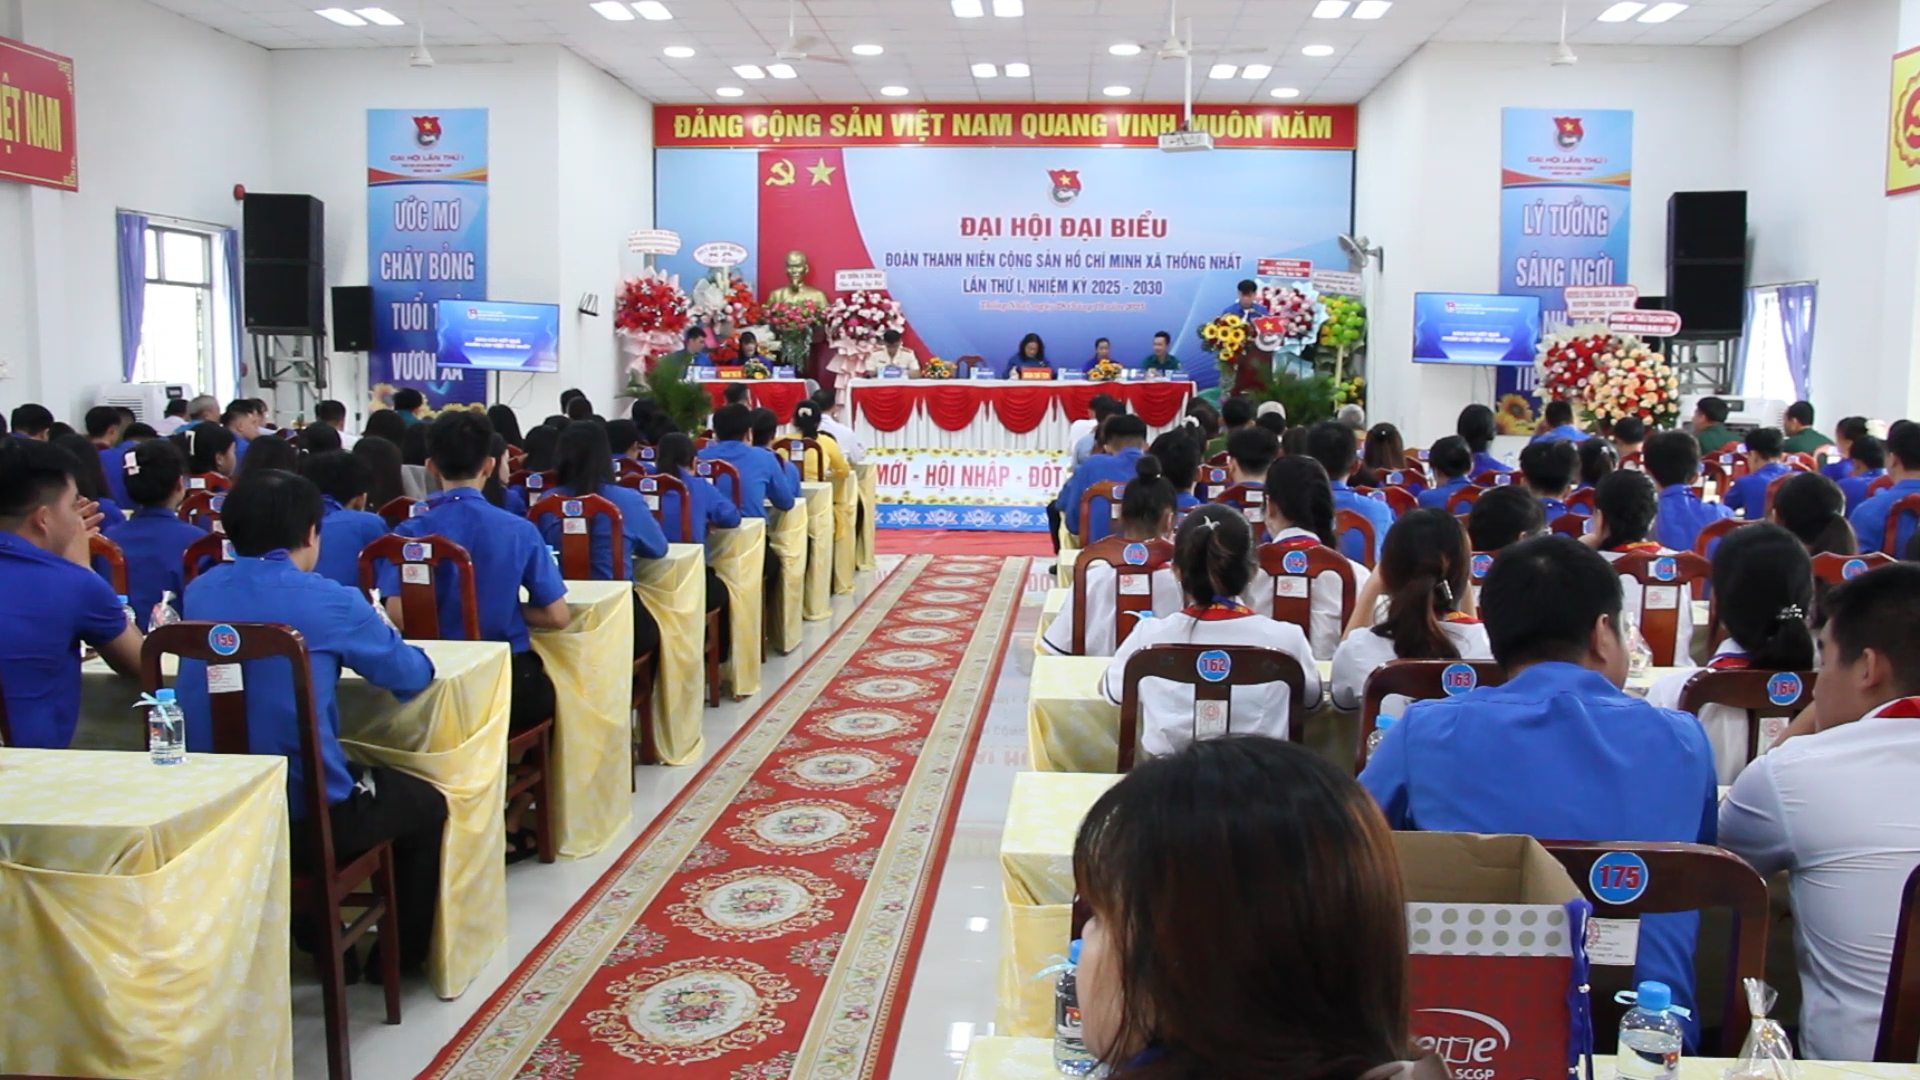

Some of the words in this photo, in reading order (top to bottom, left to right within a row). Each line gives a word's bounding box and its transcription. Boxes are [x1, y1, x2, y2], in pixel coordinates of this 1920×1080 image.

[24, 90, 62, 152] NAM
[674, 107, 743, 138] ĐẢNG
[751, 110, 821, 142] CỘNG
[829, 106, 883, 137] SẢN
[891, 109, 944, 141] VIỆT
[952, 113, 1013, 137] NAM
[1021, 112, 1108, 139] QUANG
[1116, 113, 1178, 138] VINH
[1271, 110, 1332, 138] NĂM
[394, 195, 428, 230] ƯỚC
[432, 198, 461, 230] MƠ
[960, 217, 1001, 241] ĐẠI
[1011, 213, 1051, 242] HỘI
[1060, 217, 1102, 242] ĐẠI
[1111, 210, 1167, 239] BIỂU
[1524, 199, 1544, 235] LÝ
[1549, 195, 1608, 237] TƯỞNG
[381, 246, 423, 280] CHÁY
[429, 242, 474, 280] BỎNG
[886, 250, 918, 267] ĐOÀN
[923, 253, 962, 267] THANH
[966, 250, 995, 267] NIÊN
[1000, 251, 1032, 270] CỘNG
[1036, 249, 1061, 268] SẢN
[1085, 250, 1105, 268] CHÍ
[1110, 254, 1141, 268] MINH
[1145, 251, 1161, 269] XÃ
[1166, 250, 1206, 269] THỐNG
[1209, 251, 1242, 269] NHẤT
[1516, 250, 1565, 287] SÁNG
[1570, 251, 1613, 287] NGỜI
[991, 276, 1014, 293] THỨ
[1028, 276, 1068, 296] NHIỆM
[1072, 276, 1087, 294] KỲ
[1091, 280, 1120, 294] 2025
[1133, 280, 1162, 295] 2030
[391, 292, 427, 330] TUỔI
[392, 350, 436, 380] VƯƠN
[877, 459, 908, 486] MỚI
[925, 460, 955, 493] HỘI
[962, 459, 1010, 492] NHẬP
[1028, 460, 1062, 495] ĐỘT
[214, 632, 236, 647] 159
[1202, 657, 1227, 672] 162
[1447, 671, 1471, 688] 163
[1772, 679, 1797, 696] 164
[1599, 864, 1641, 889] 175
[1455, 1068, 1495, 1080] SCGP
